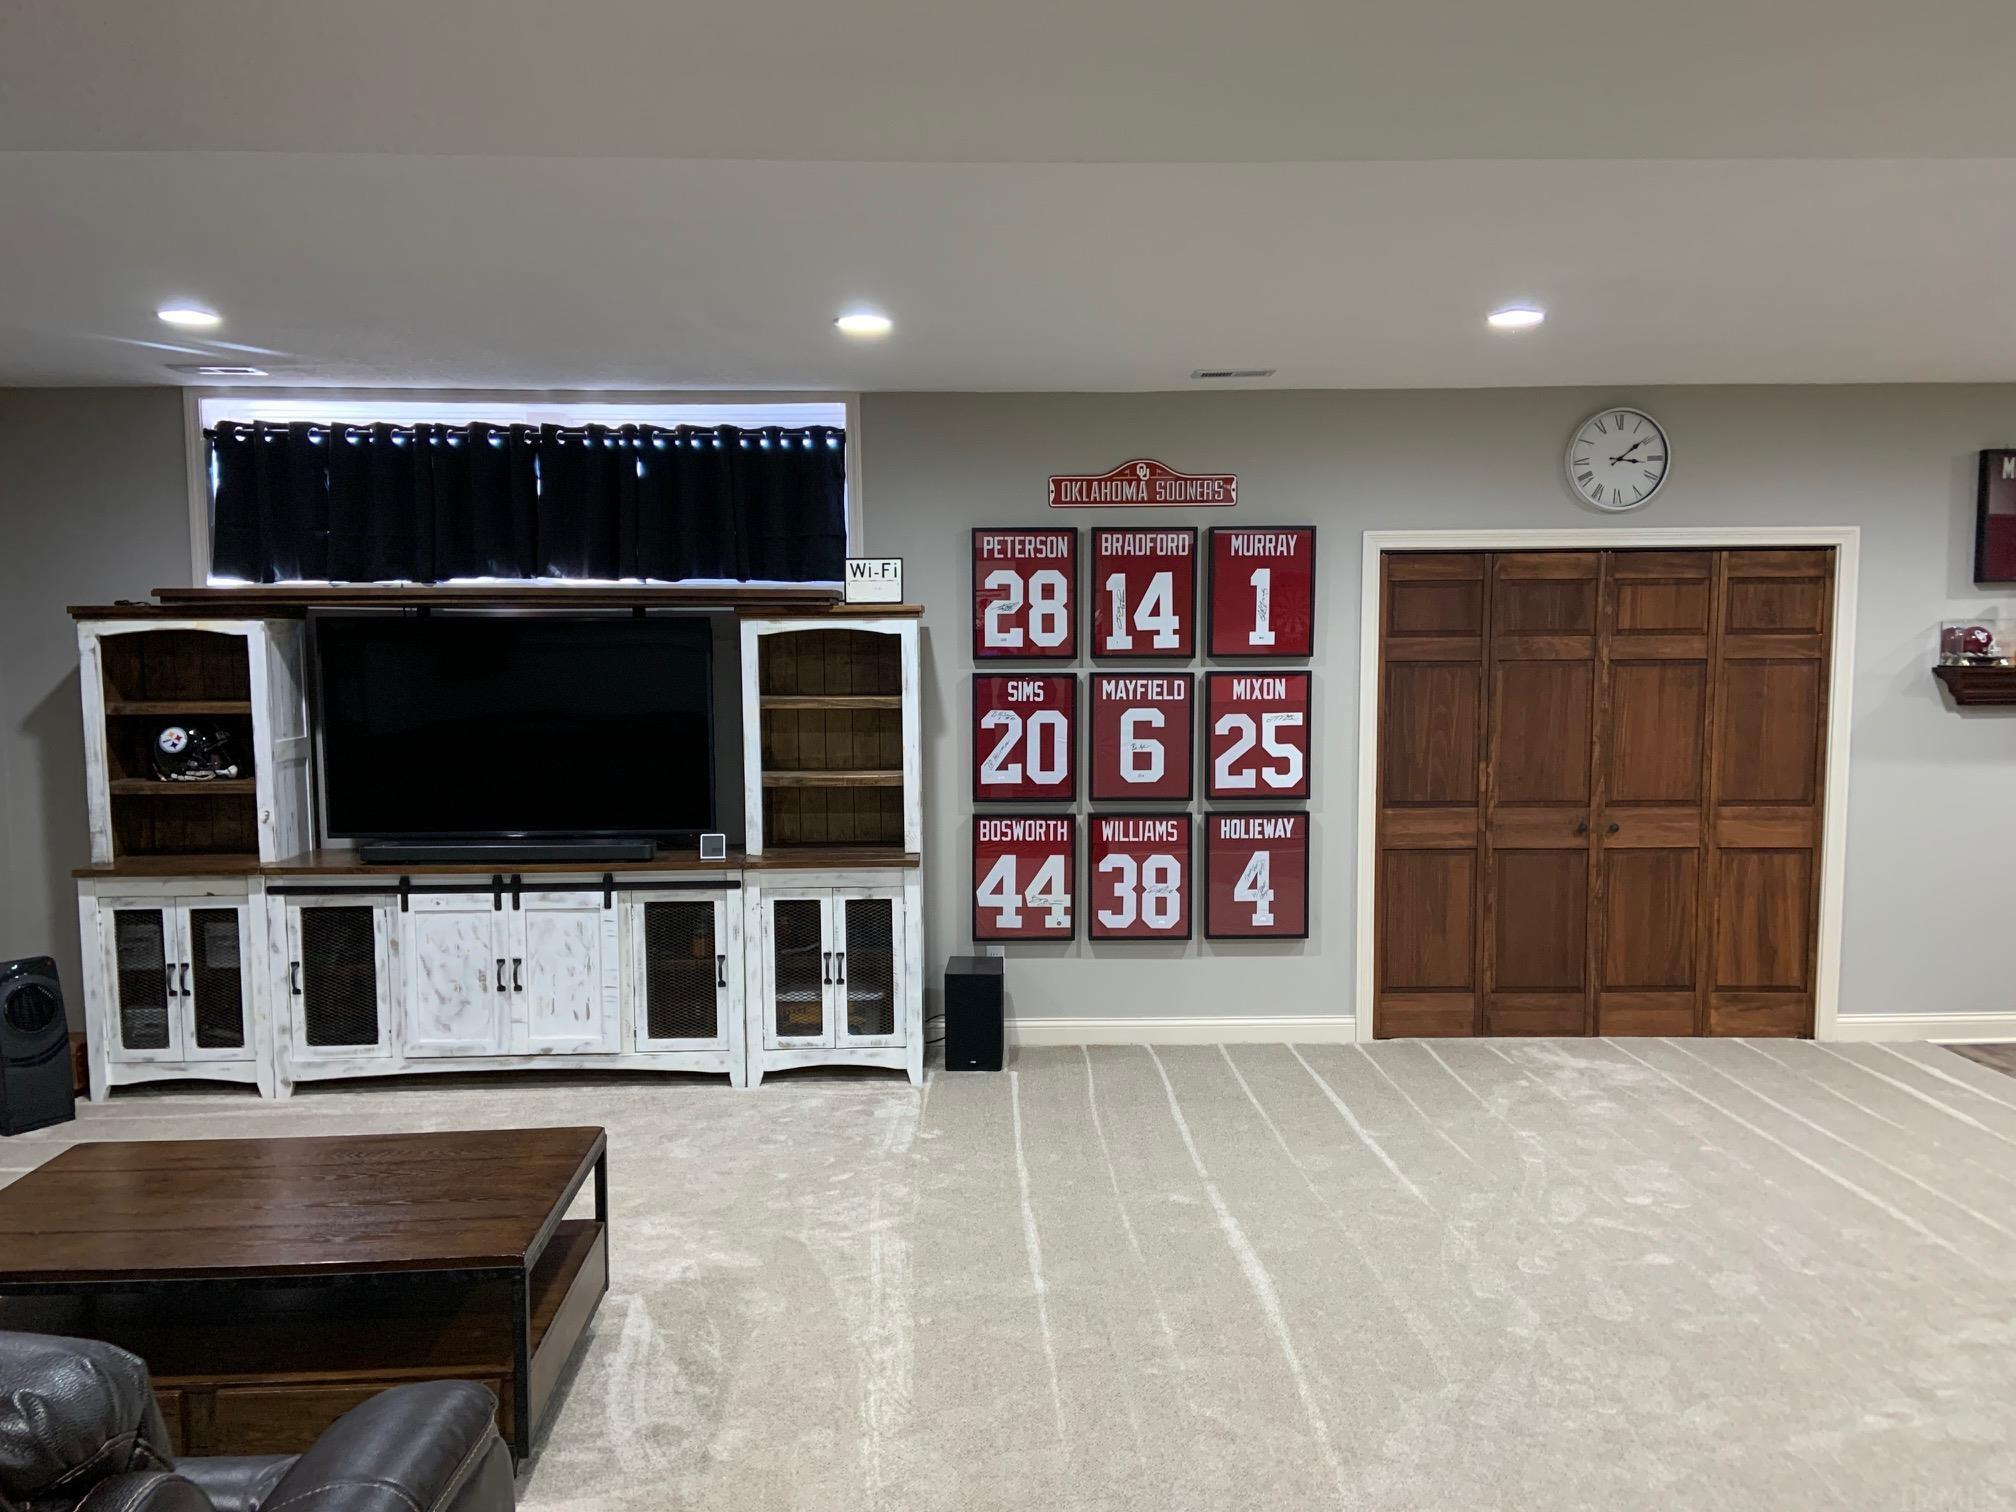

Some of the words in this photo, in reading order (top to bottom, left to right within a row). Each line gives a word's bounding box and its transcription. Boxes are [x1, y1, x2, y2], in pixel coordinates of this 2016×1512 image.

[1061, 480, 1148, 502] OKLAHOMA
[1156, 479, 1224, 501] SOONERS
[983, 536, 1068, 559] PETERSON
[1101, 533, 1189, 556] BRADFORD
[1230, 534, 1298, 557] MURRAY
[849, 562, 897, 579] Wi-Fi
[984, 569, 1068, 648] 28
[1105, 571, 1180, 650] 14
[1249, 568, 1276, 646] 1
[1007, 681, 1044, 702] SIMS
[1102, 679, 1185, 701] MAYFIELD
[1232, 678, 1286, 700] MIXON
[980, 709, 1068, 785] 20
[1120, 707, 1165, 783] 6
[1214, 712, 1303, 789] 25
[979, 820, 1068, 842] BOSWORTH
[1102, 820, 1178, 842] WILLIAMS
[1220, 818, 1295, 840] HOLIEWAY
[976, 854, 1071, 929] 44
[1098, 853, 1181, 929] 38
[1233, 850, 1274, 926] 4
